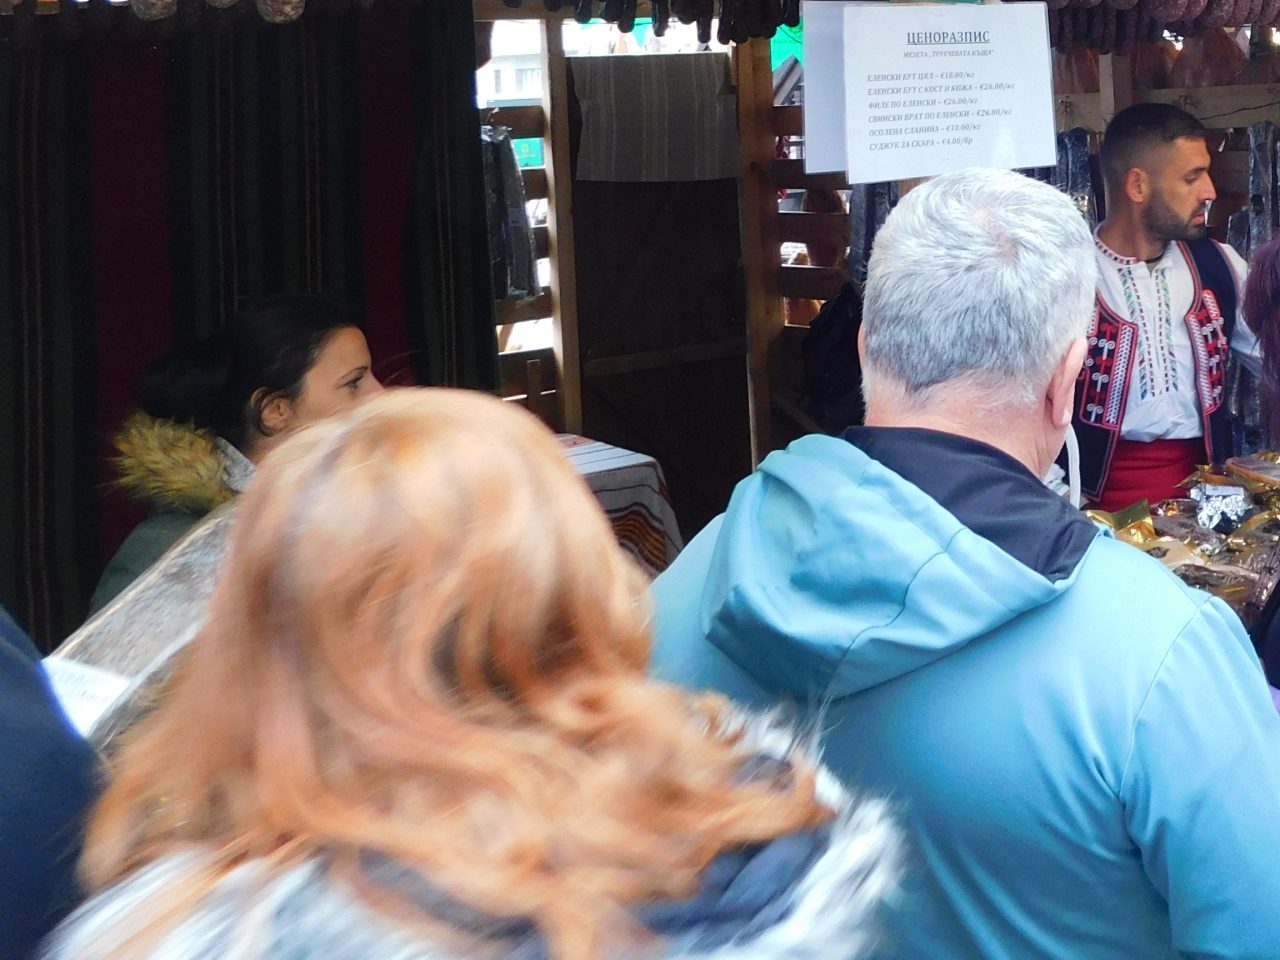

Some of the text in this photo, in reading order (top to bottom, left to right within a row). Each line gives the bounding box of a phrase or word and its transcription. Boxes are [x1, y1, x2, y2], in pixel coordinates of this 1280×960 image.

[906, 31, 991, 45] ЦЕНОРАЗПИС
[867, 73, 901, 82] ЕЛЕНСКИ
[902, 73, 917, 81] БУТ
[867, 87, 901, 96] ЕЛЕНСКИ
[903, 86, 917, 94] БУТ
[924, 85, 943, 93] КОСТ
[951, 84, 973, 92] КОЖА
[868, 101, 890, 109] ФИЛЕ
[890, 100, 901, 108] ПО
[902, 99, 937, 107] ЕЛЕНСКИ
[868, 114, 903, 123] СВИНСКИ
[904, 113, 923, 121] ВРАТ
[924, 112, 935, 120] ПО
[936, 110, 970, 119] ЕЛЕНСКИ
[869, 128, 903, 137] ОСОЛЕНА
[904, 125, 939, 135] СЛАНИНА
[869, 141, 900, 151] СУДЖУК
[900, 140, 910, 149] ЗА
[911, 139, 935, 148] СКАРА
